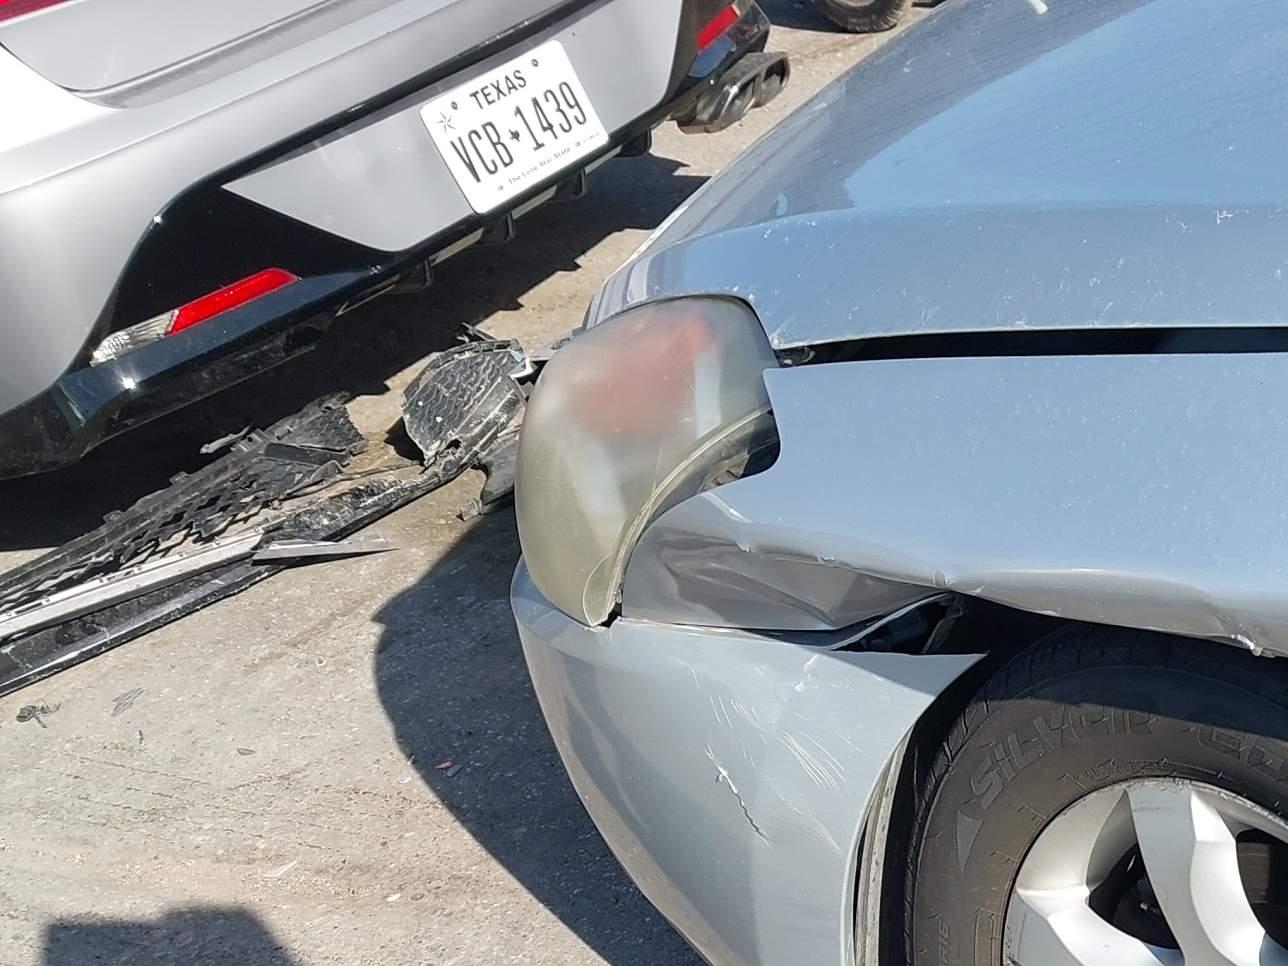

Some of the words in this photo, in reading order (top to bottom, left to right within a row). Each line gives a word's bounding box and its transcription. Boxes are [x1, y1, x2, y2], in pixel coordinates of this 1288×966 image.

[449, 121, 514, 184] VCB
[514, 81, 587, 151] 1439
[469, 69, 527, 110] TEXAS
[970, 709, 1157, 811] SILVER
